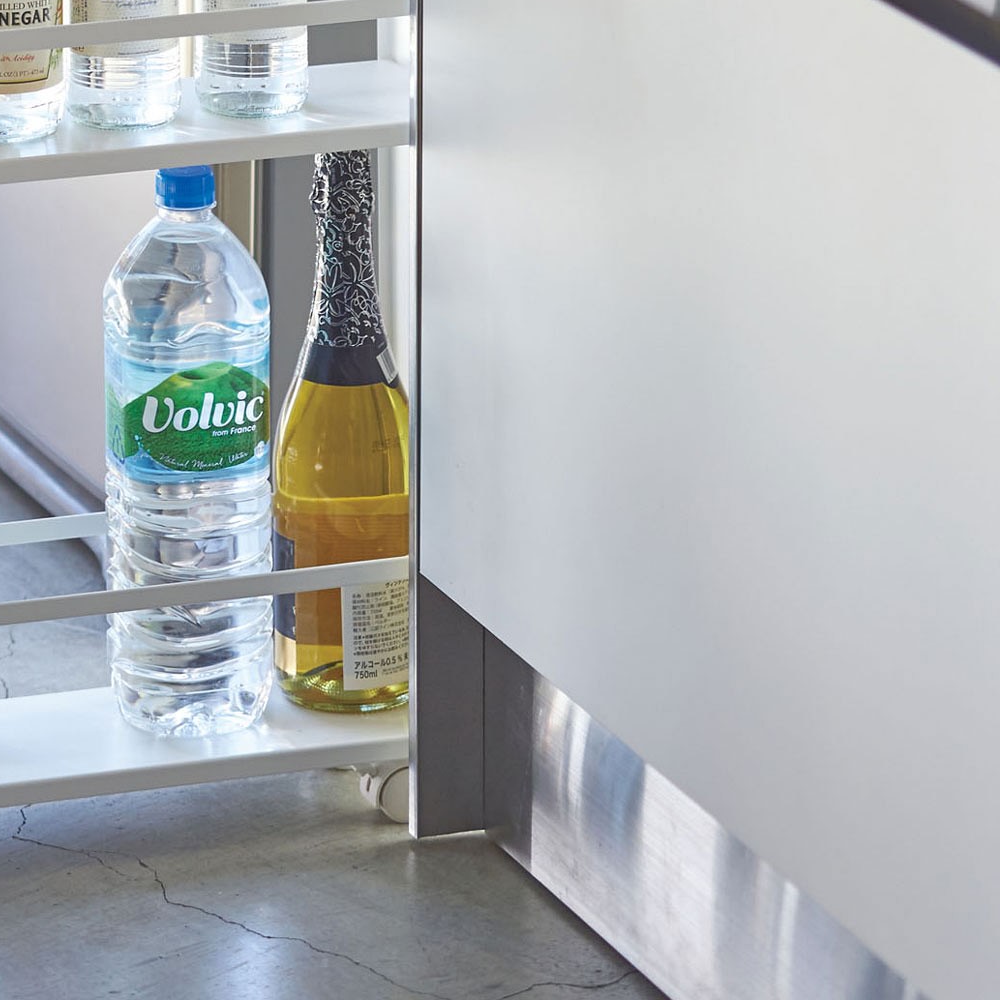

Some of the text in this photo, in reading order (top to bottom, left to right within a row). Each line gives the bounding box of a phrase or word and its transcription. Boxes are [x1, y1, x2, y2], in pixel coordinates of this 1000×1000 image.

[142, 390, 265, 434] Volvic
[211, 424, 257, 437] from France
[354, 669, 378, 680] 750ml
